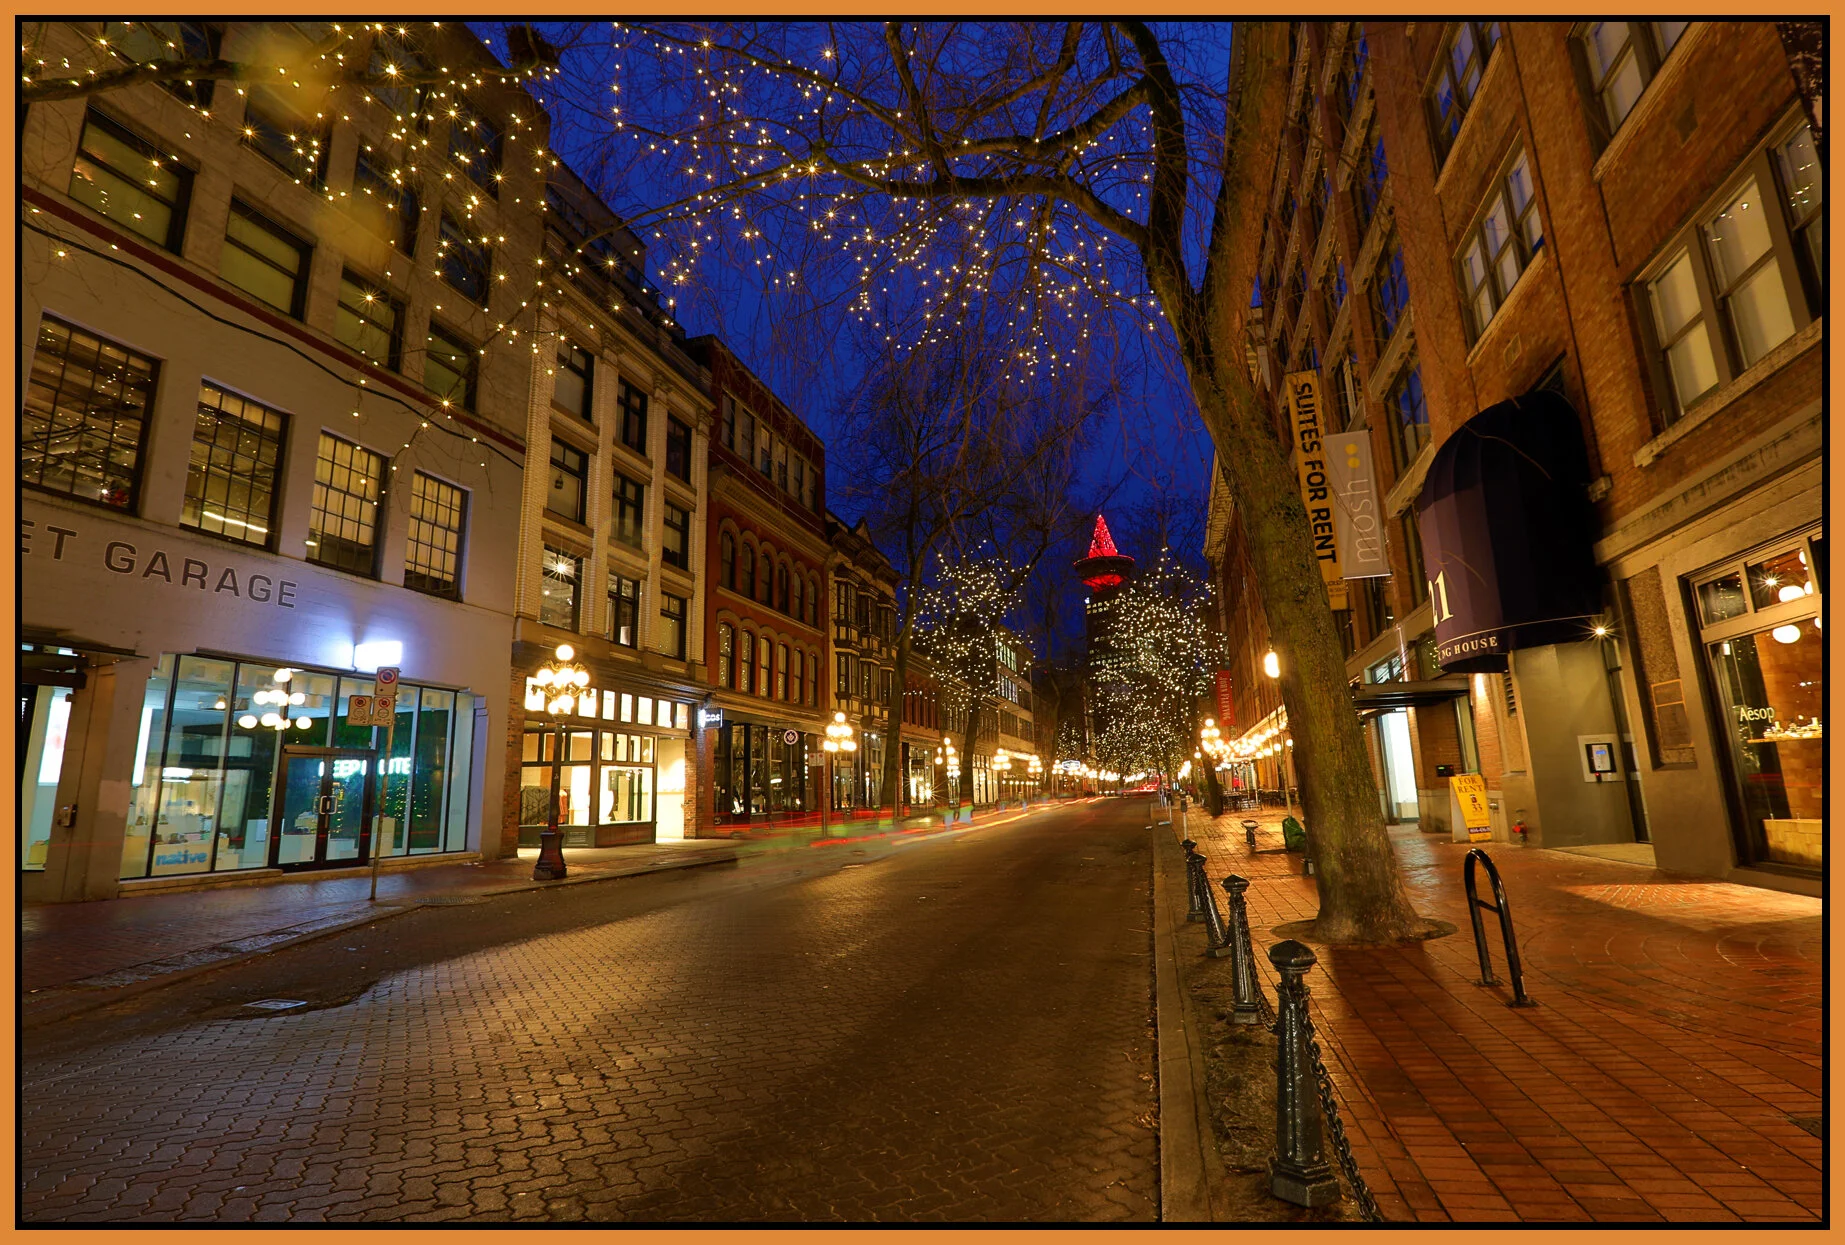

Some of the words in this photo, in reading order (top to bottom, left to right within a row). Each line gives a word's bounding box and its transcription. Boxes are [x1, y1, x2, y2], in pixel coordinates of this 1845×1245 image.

[1295, 382, 1321, 454] SUITES
[1304, 459, 1328, 502] FOR
[1311, 507, 1337, 564] RENT
[1339, 478, 1380, 563] mosh
[103, 540, 299, 610] GARAGE
[1454, 636, 1498, 655] HOUSE
[1457, 784, 1483, 794] RENT
[1458, 776, 1478, 786] FOR
[155, 849, 208, 867] native
